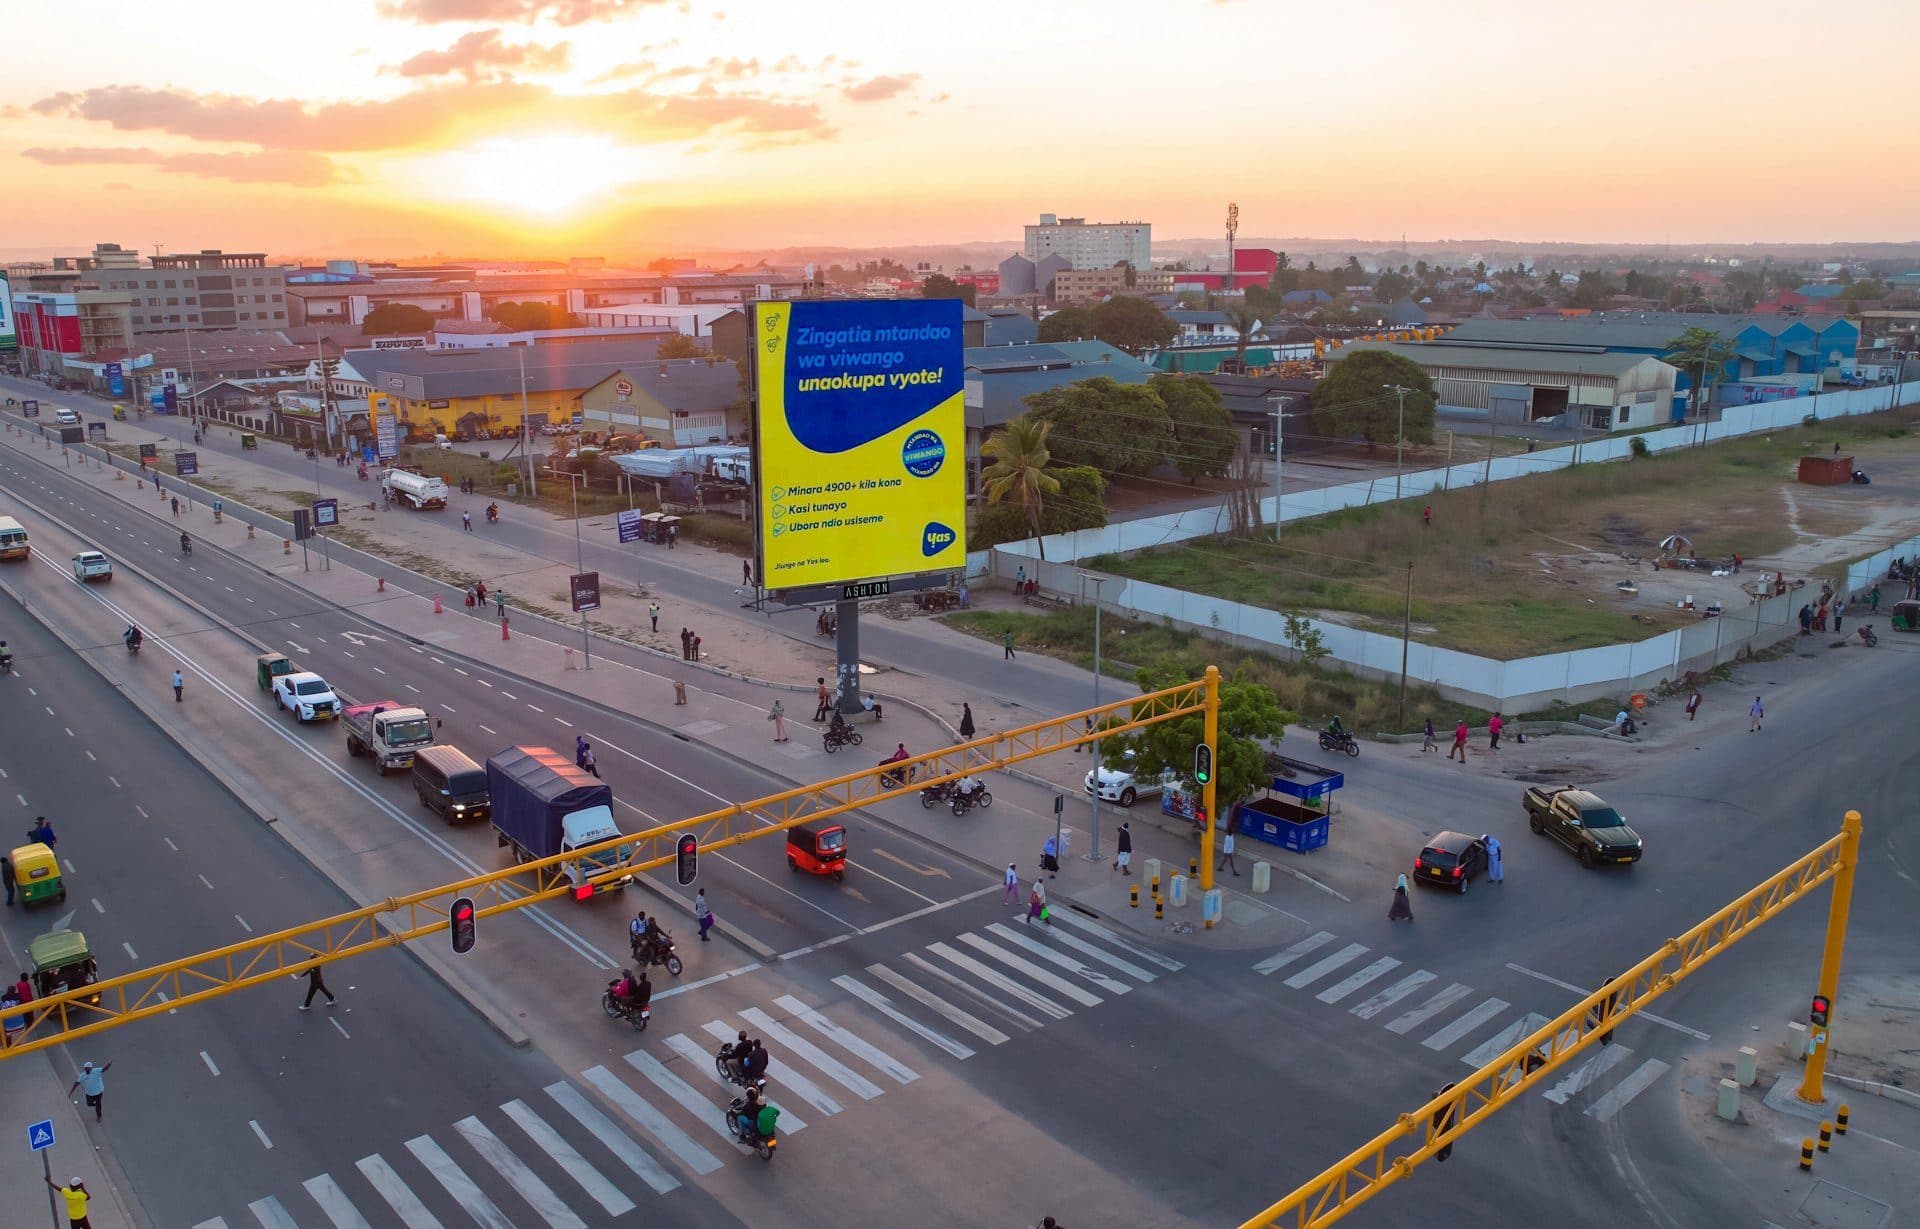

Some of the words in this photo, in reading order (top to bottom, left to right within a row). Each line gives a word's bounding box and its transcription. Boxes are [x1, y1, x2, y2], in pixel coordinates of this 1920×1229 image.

[765, 319, 776, 328] 5G
[796, 325, 872, 348] Zingatia
[875, 323, 951, 342] mtandao
[767, 341, 777, 349] 4G
[798, 354, 826, 368] wa
[830, 349, 904, 369] viwango
[798, 372, 886, 392] unaokupa
[889, 366, 943, 390] vyote!
[906, 433, 931, 450] MTANDAO
[904, 447, 944, 462] VIWANGO
[788, 486, 823, 496] Minara
[825, 481, 857, 493] 4900+
[859, 479, 877, 490] kila
[878, 478, 902, 488] kona
[788, 503, 811, 515] Kasi
[812, 501, 848, 513] tunayo
[789, 522, 820, 532] Ubora
[821, 518, 843, 529] ndio
[844, 515, 884, 526] usiseme
[927, 532, 951, 549] yas
[845, 583, 888, 598] ASHTON
